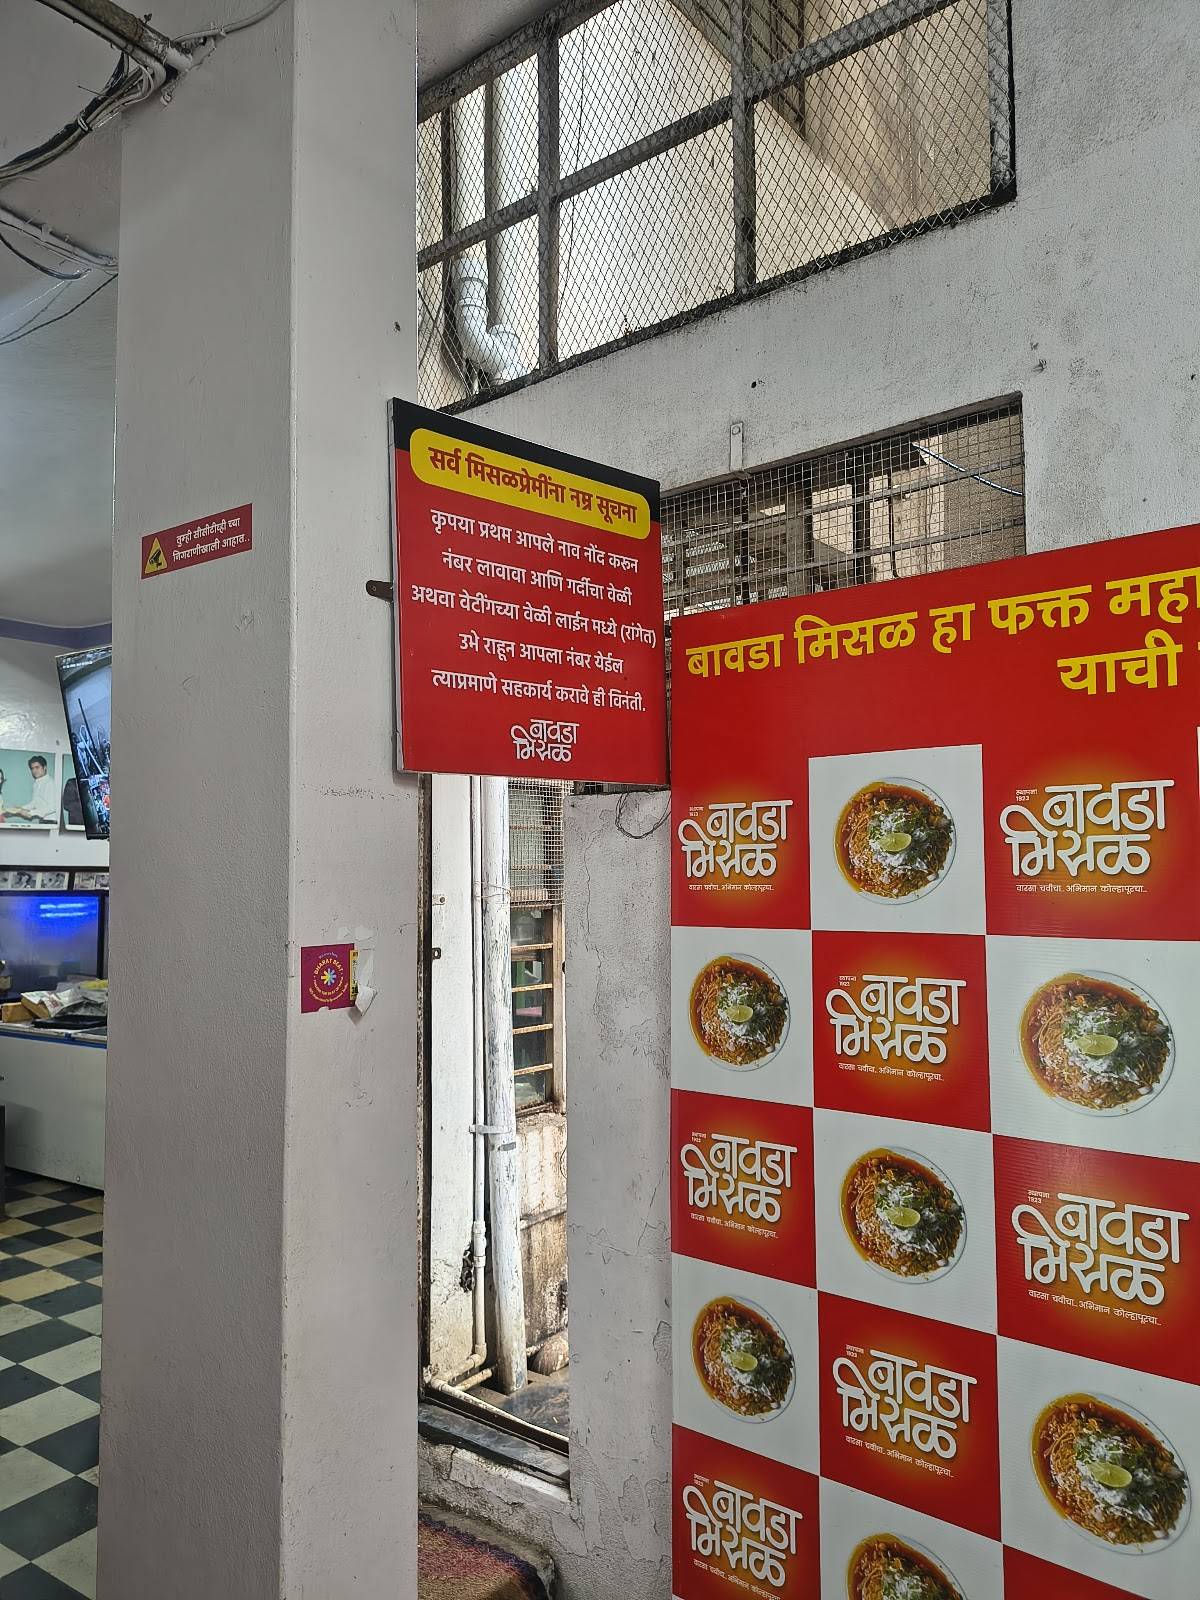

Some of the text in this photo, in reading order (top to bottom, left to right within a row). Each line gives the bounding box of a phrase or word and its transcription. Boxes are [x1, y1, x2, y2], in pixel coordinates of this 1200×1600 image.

[428, 446, 637, 524] सर्व मिसळप्रेमींना नम्र सूचना
[176, 530, 192, 547] तुम्ही
[228, 518, 240, 528] च्या
[430, 508, 638, 573] कृपया प्रथम आपले नाव नोंद करून
[442, 547, 632, 605] नंबर लावावा आणि गर्दीचा वेळी
[412, 585, 656, 648] अथवा वेटींगच्या वेळी लाईन मध्ये (रांगेत)
[686, 634, 784, 678] बावडा
[794, 612, 918, 664] मिसळ
[929, 603, 976, 655] हा
[988, 584, 1092, 635] फक्त
[458, 630, 624, 674] उभे राहून आपला नंबर येईल
[1058, 628, 1183, 695] याची
[431, 668, 497, 694] त्याप्रमाणे
[501, 678, 552, 701] सहकार्य
[555, 684, 588, 706] करावे
[593, 690, 606, 708] ही
[510, 725, 572, 763] मिसळ
[530, 718, 580, 745] बावडा
[706, 800, 793, 843] बावडा
[1043, 780, 1174, 834] बावडा
[678, 819, 777, 878] मिसळ
[1000, 804, 1150, 876] मिसळ
[826, 989, 947, 1064] मिसळ
[860, 974, 966, 1025] बावडा
[680, 1144, 782, 1222] मिसळ
[710, 1134, 798, 1188] बावडा
[1012, 1204, 1165, 1306] मिसळ
[1056, 1193, 1190, 1264] बावडा
[832, 1357, 958, 1459] मिसळ
[868, 1350, 978, 1422] बावडा
[682, 1485, 786, 1587] मिसळ
[712, 1480, 803, 1554] बावडा
